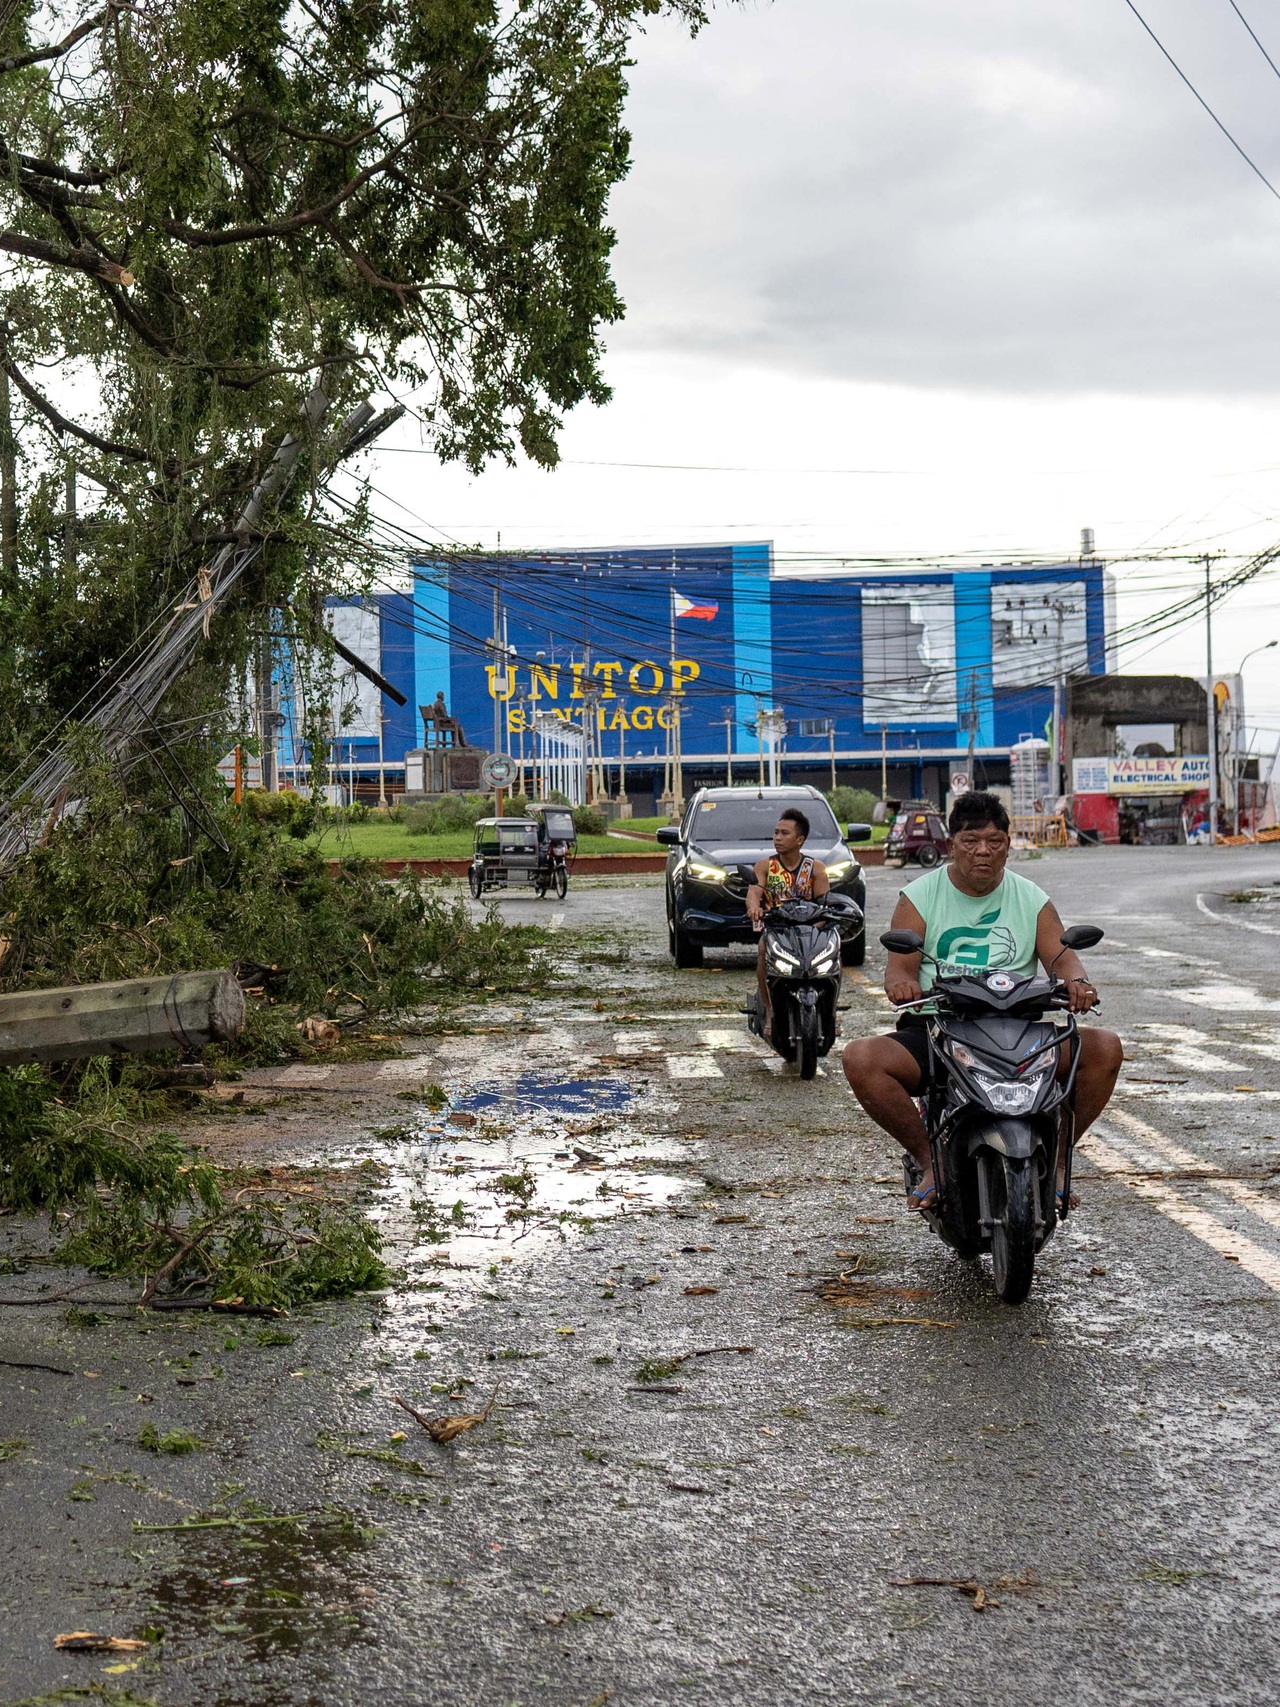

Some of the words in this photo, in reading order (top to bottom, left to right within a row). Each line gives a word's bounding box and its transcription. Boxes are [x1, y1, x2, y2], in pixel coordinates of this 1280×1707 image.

[484, 659, 701, 701] UNITOP
[508, 705, 679, 733] SNTIAGO
[1113, 760, 1178, 772] VALLEY
[1113, 773, 1177, 783] ELECTRICAL
[1180, 773, 1210, 782] SHOP
